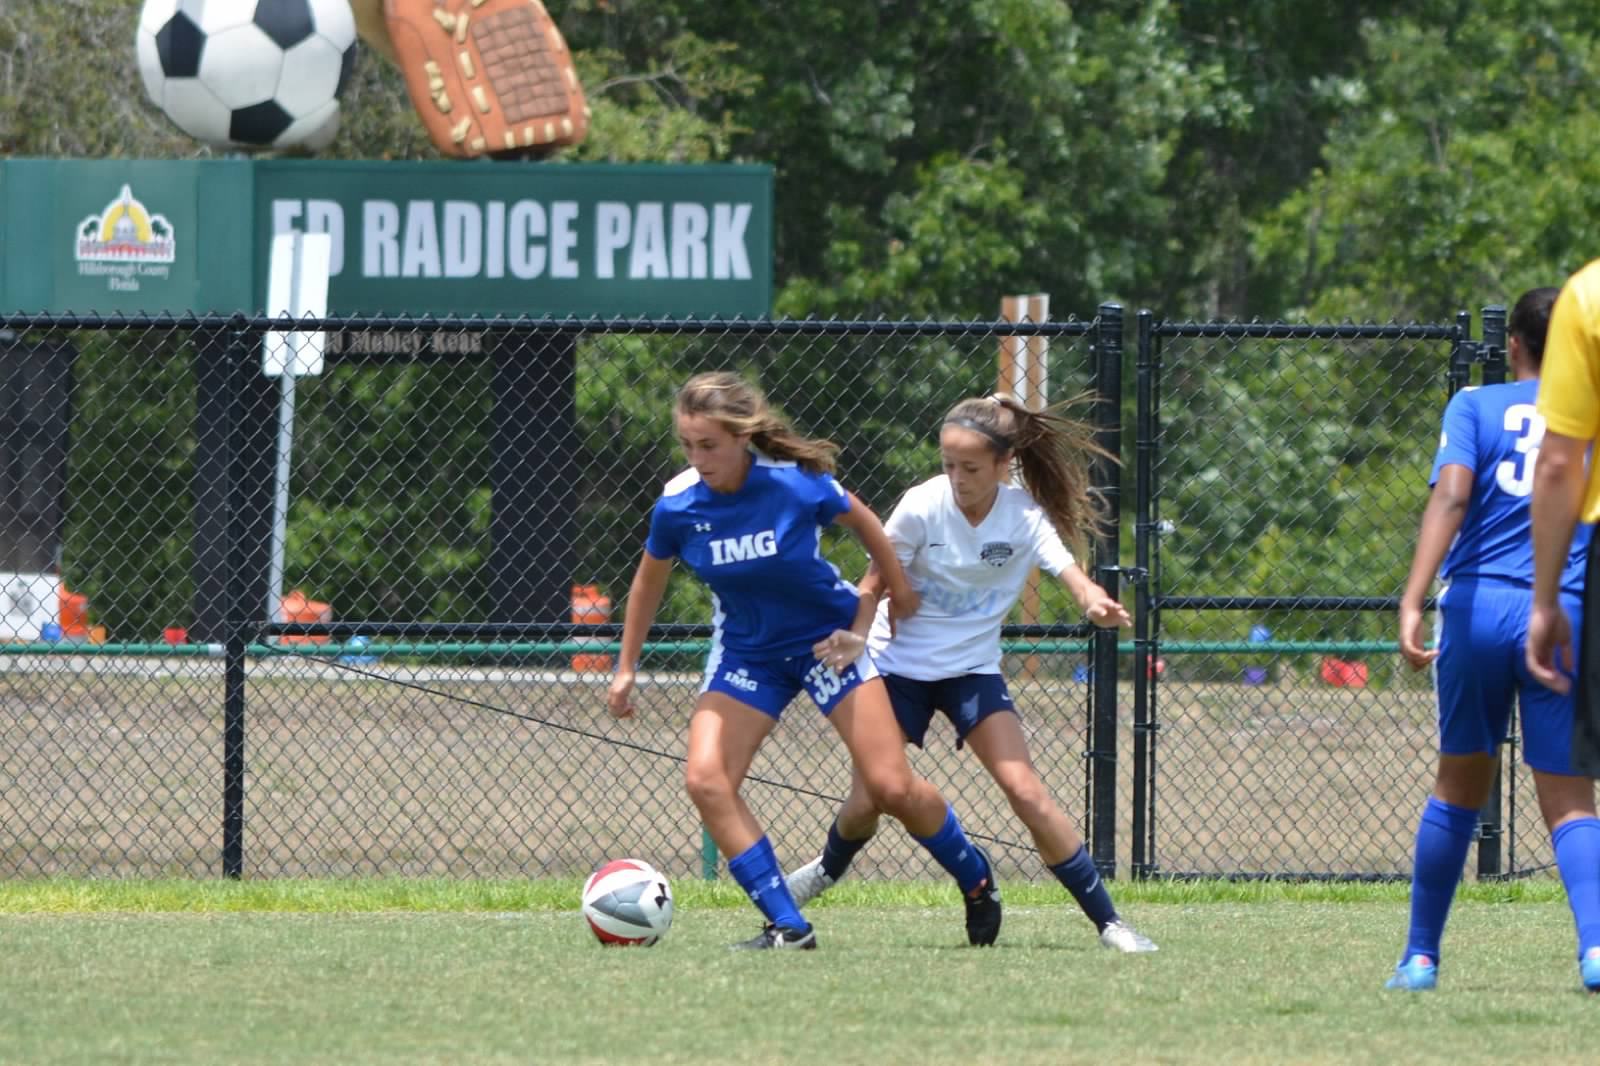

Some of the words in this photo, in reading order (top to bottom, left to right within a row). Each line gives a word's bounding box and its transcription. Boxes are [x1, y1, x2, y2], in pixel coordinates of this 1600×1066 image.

[362, 199, 579, 279] RADICE
[595, 202, 753, 281] PARK
[709, 529, 777, 566] IMG
[723, 671, 758, 692] IMG
